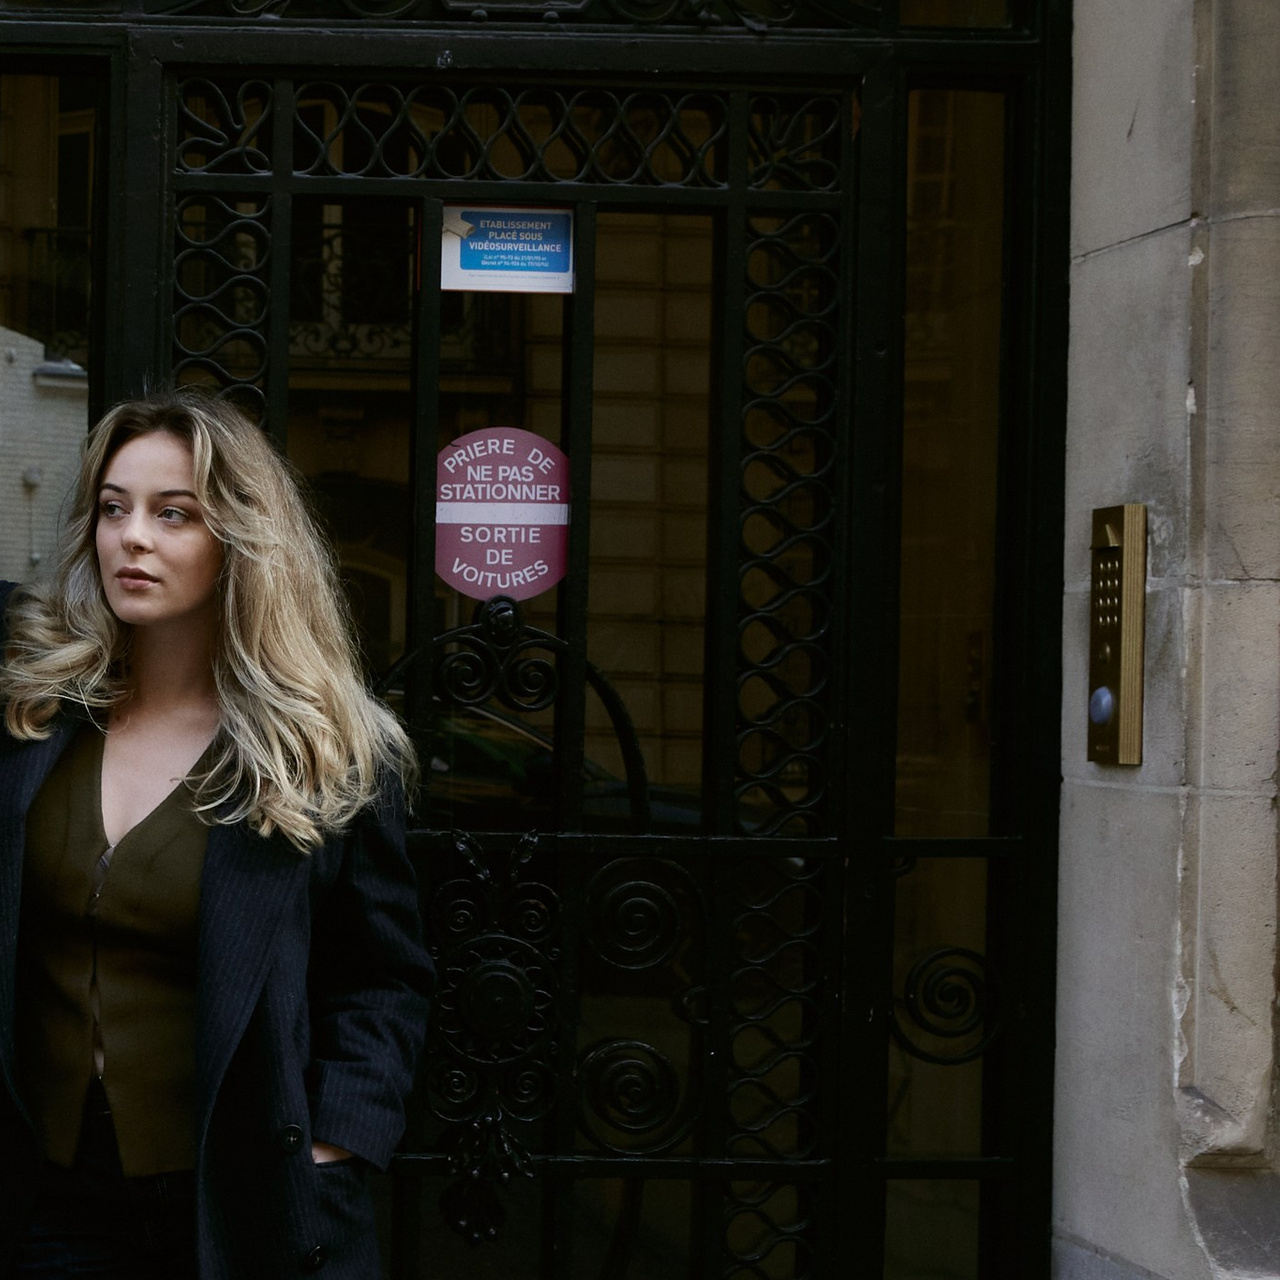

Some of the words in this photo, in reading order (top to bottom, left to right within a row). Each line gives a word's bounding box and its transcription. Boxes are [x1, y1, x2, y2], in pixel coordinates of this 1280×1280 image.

[480, 220, 552, 230] ETABLISSEMENT
[488, 230, 517, 240] PLACÉ
[519, 233, 543, 241] SOUS
[469, 240, 562, 253] VIDÉOSURVEILLANCE
[443, 438, 516, 474] PRIERE
[526, 447, 556, 475] DE
[467, 465, 493, 481] NE
[498, 465, 534, 482] PAS
[440, 483, 560, 501] STATIONNER
[460, 526, 541, 544] SORTIE
[486, 548, 514, 565] DE
[451, 557, 549, 589] VOITURES
